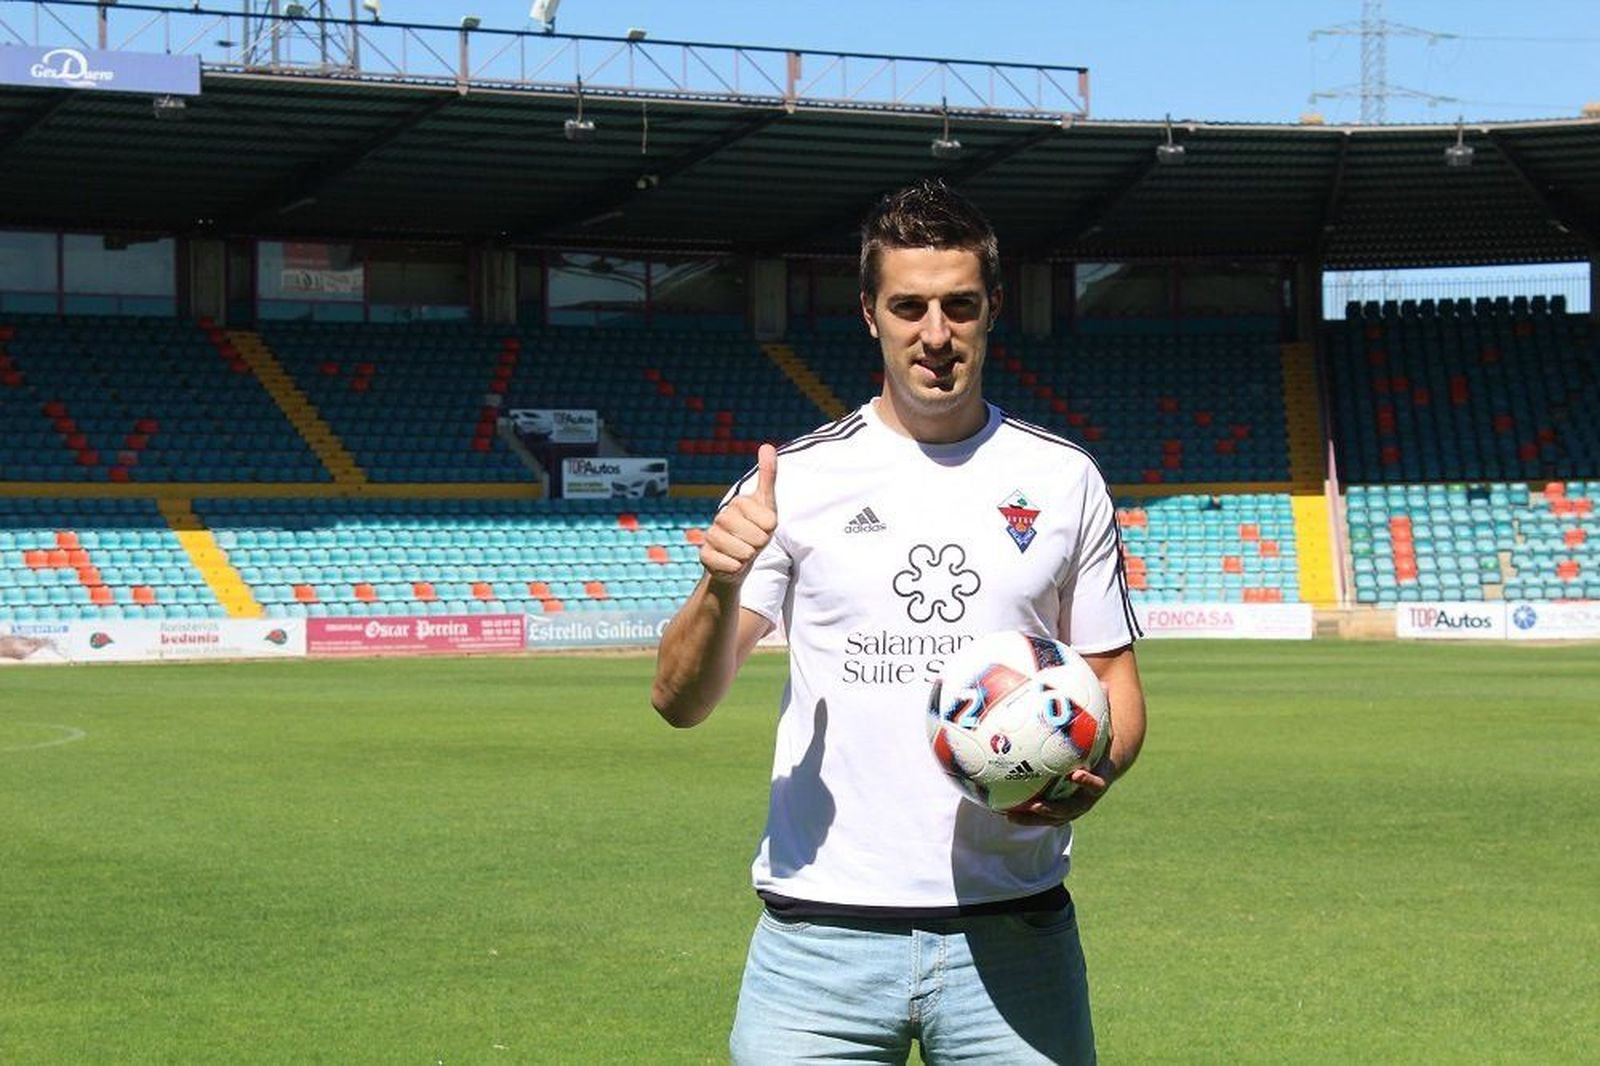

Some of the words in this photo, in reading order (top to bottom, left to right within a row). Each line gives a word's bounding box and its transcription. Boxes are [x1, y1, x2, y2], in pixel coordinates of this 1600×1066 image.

[844, 522, 887, 534] adidas
[1147, 611, 1235, 627] FONCASA
[1410, 607, 1492, 629] TOPAutos
[365, 621, 410, 638] Oscar
[529, 622, 592, 641] Estrella
[597, 620, 653, 639] Galicia
[842, 660, 915, 684] Suite
